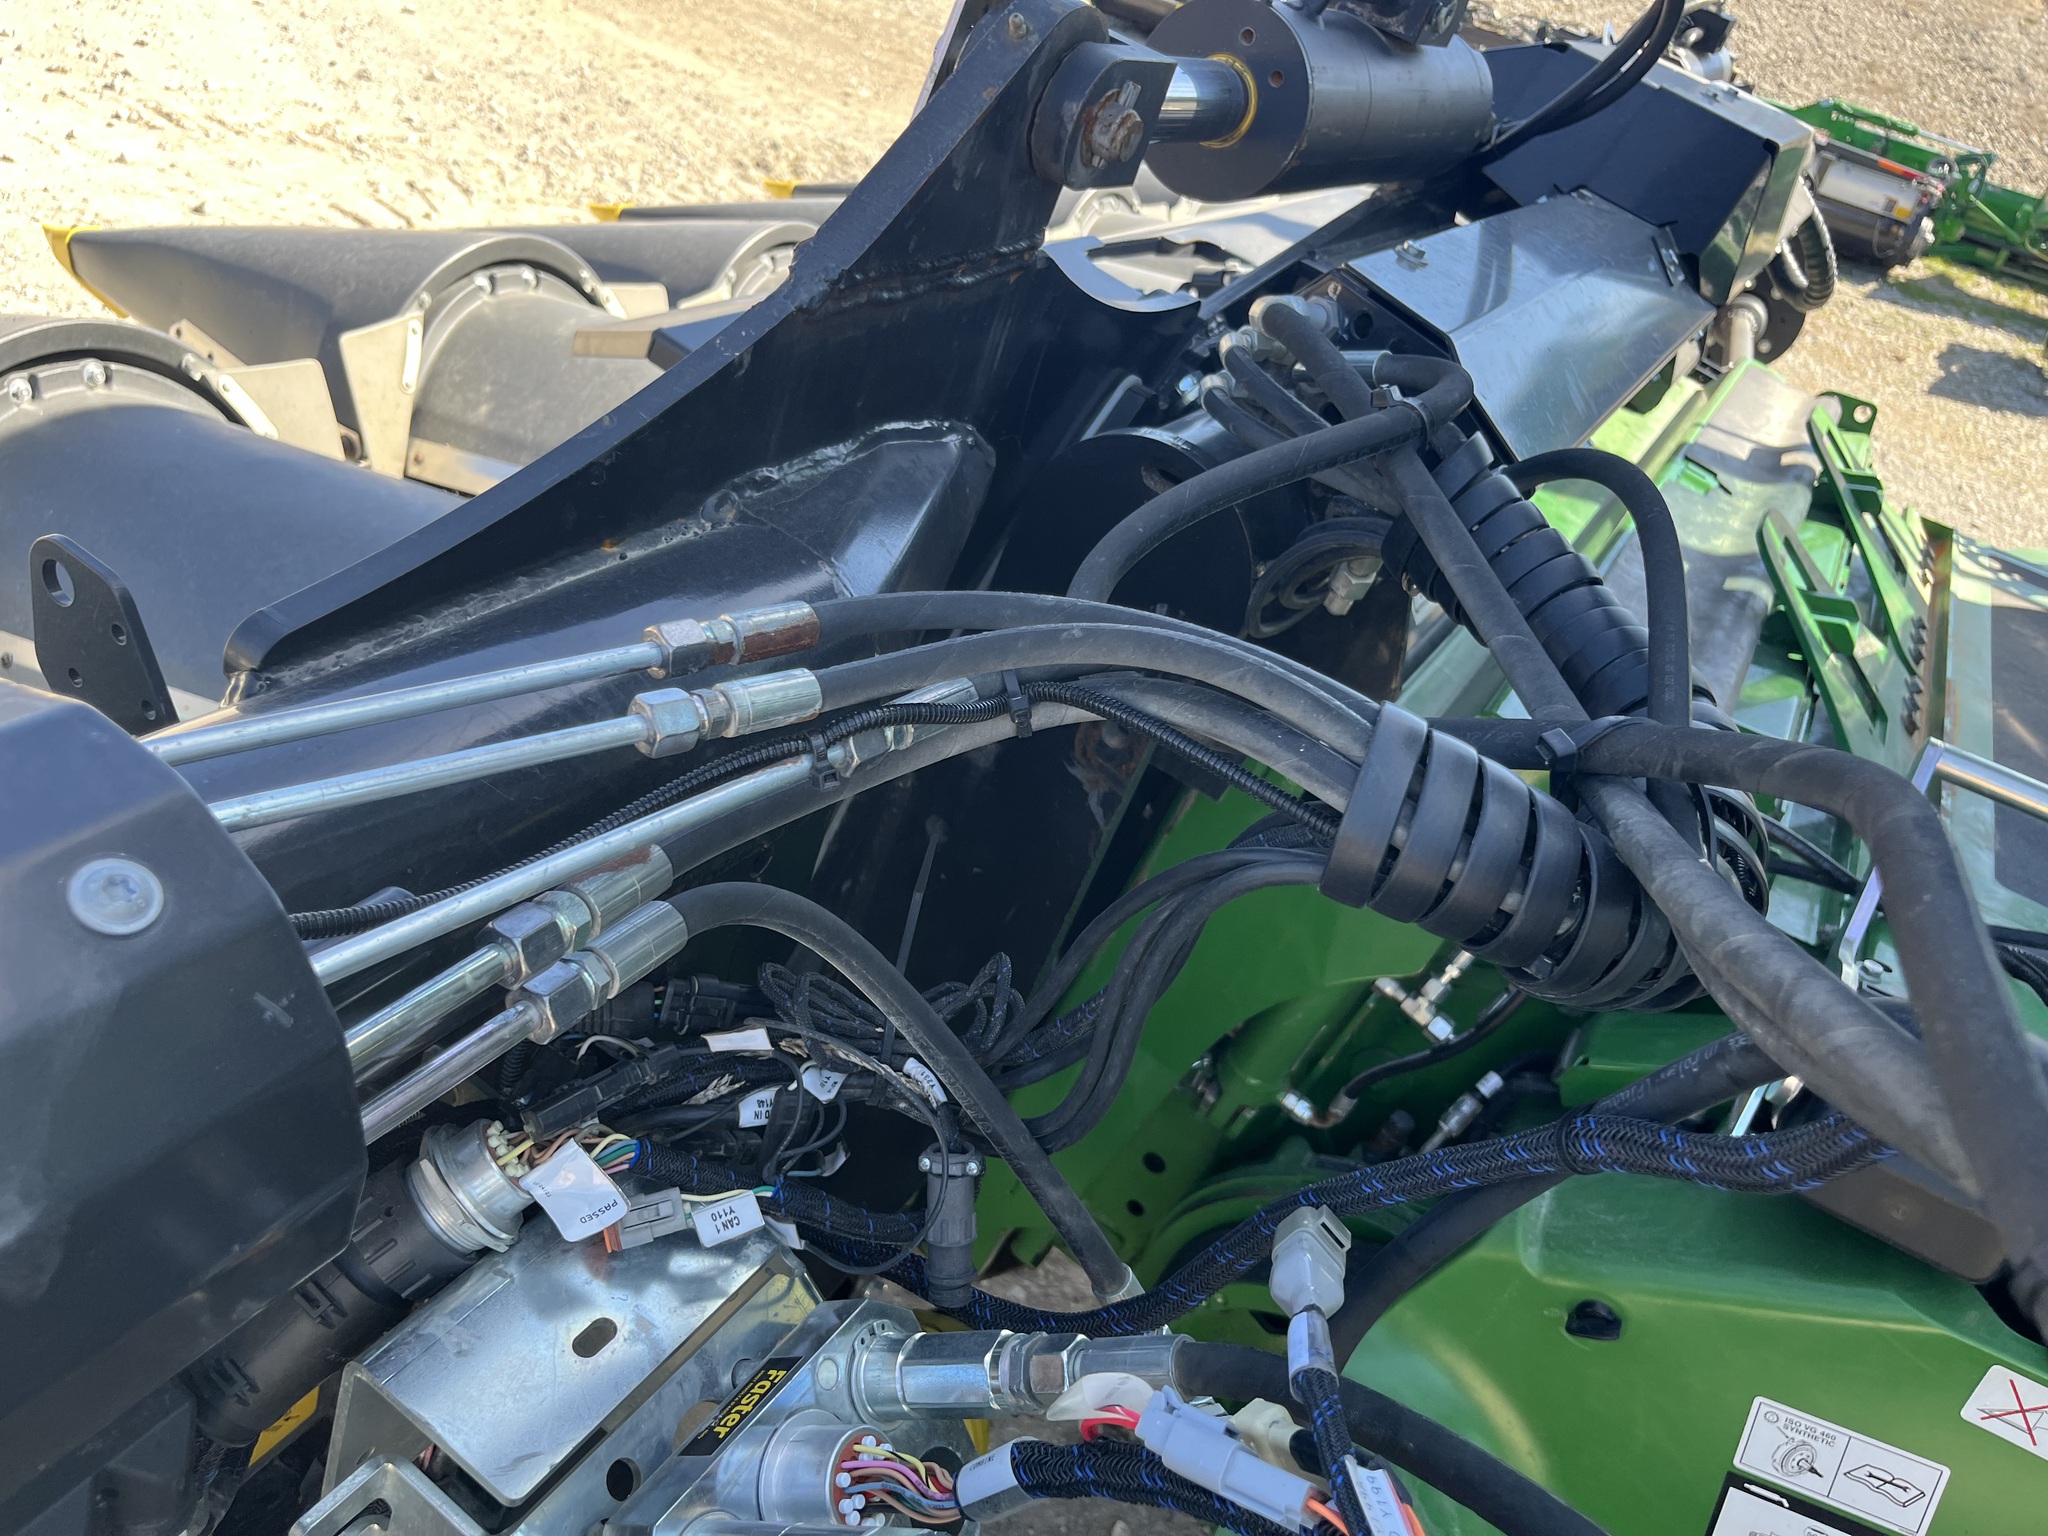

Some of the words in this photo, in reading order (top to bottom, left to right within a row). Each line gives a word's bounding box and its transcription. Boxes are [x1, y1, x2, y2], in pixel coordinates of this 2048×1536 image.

[580, 1199, 618, 1224] PASSED
[711, 1205, 736, 1222] Y110
[721, 1215, 741, 1231] CAN
[715, 1224, 721, 1234] 1
[713, 1369, 787, 1438] Faster
[1783, 1423, 1836, 1447] SYNTHETIC
[1784, 1417, 1802, 1428] ISO
[1804, 1423, 1817, 1434] VG
[1820, 1430, 1837, 1441] 460
